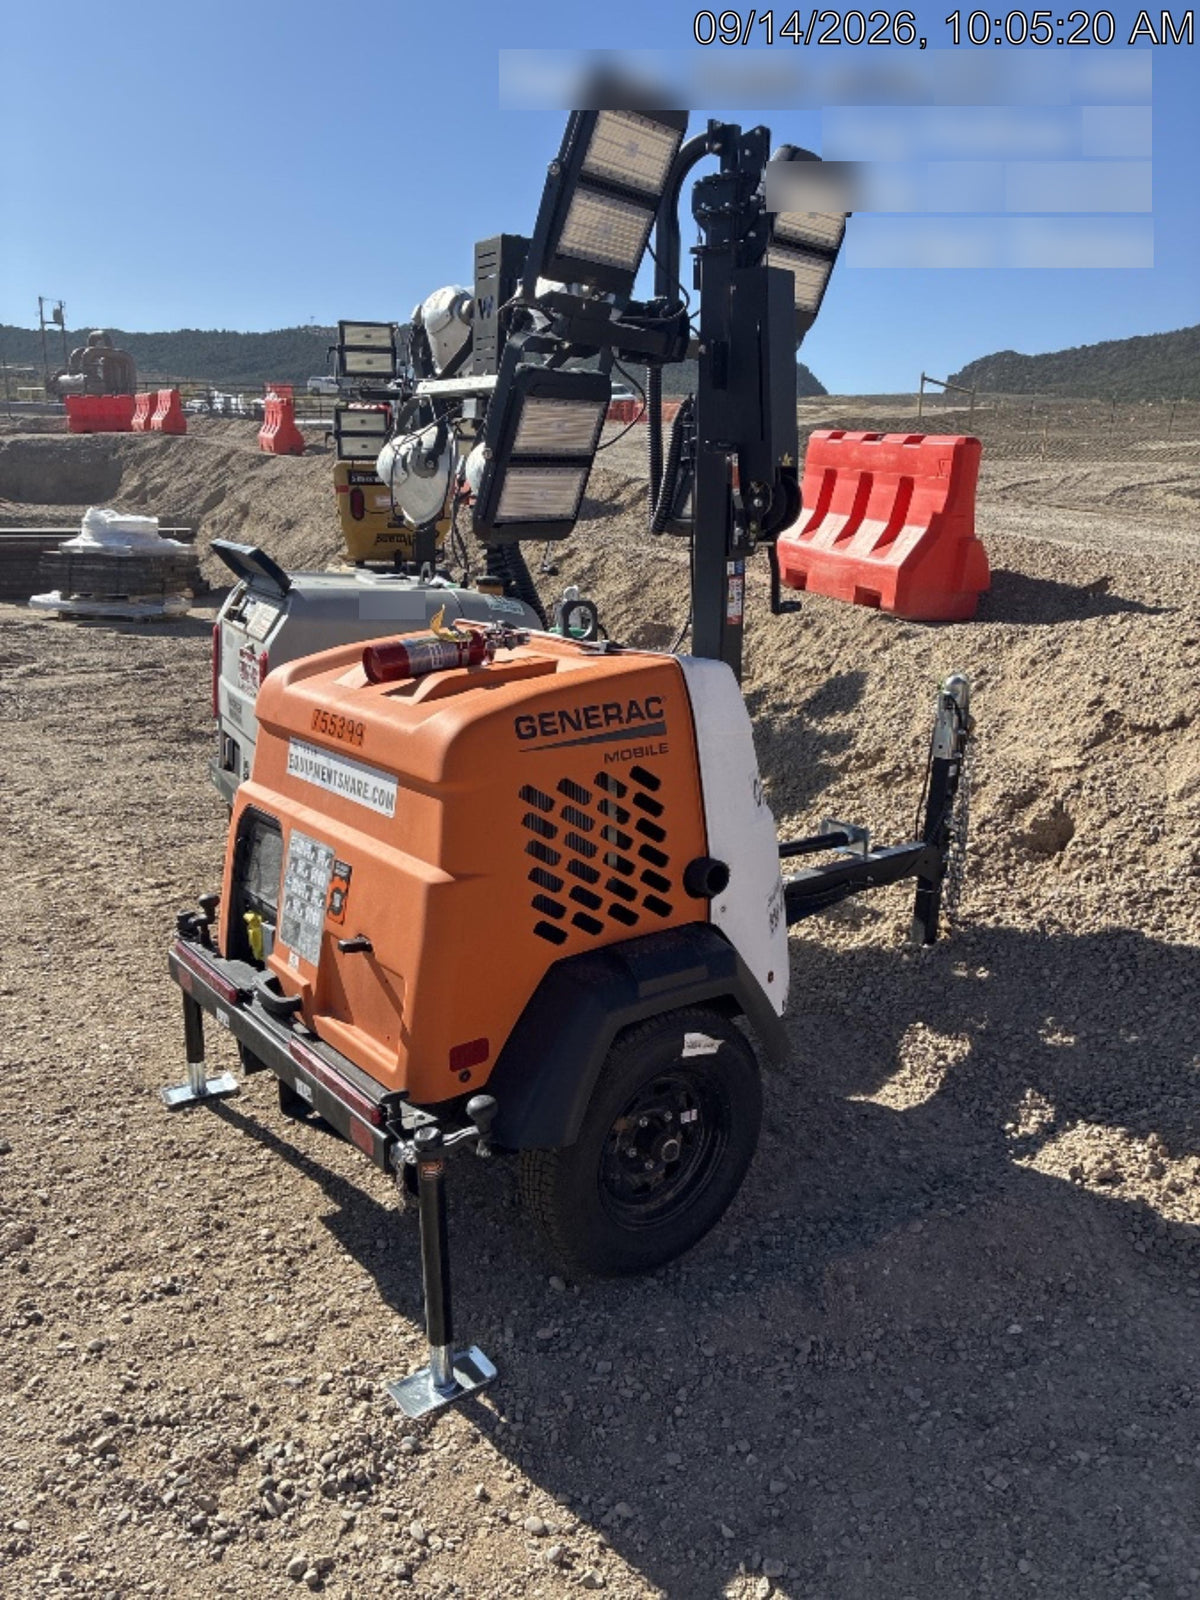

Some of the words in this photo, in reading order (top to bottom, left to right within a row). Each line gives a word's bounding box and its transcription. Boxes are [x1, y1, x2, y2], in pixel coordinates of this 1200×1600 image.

[311, 708, 366, 747] 755399
[514, 696, 664, 740] GENERAC
[604, 743, 669, 763] MOBILE
[288, 753, 395, 811] EQUIPMENTSHARE.COM
